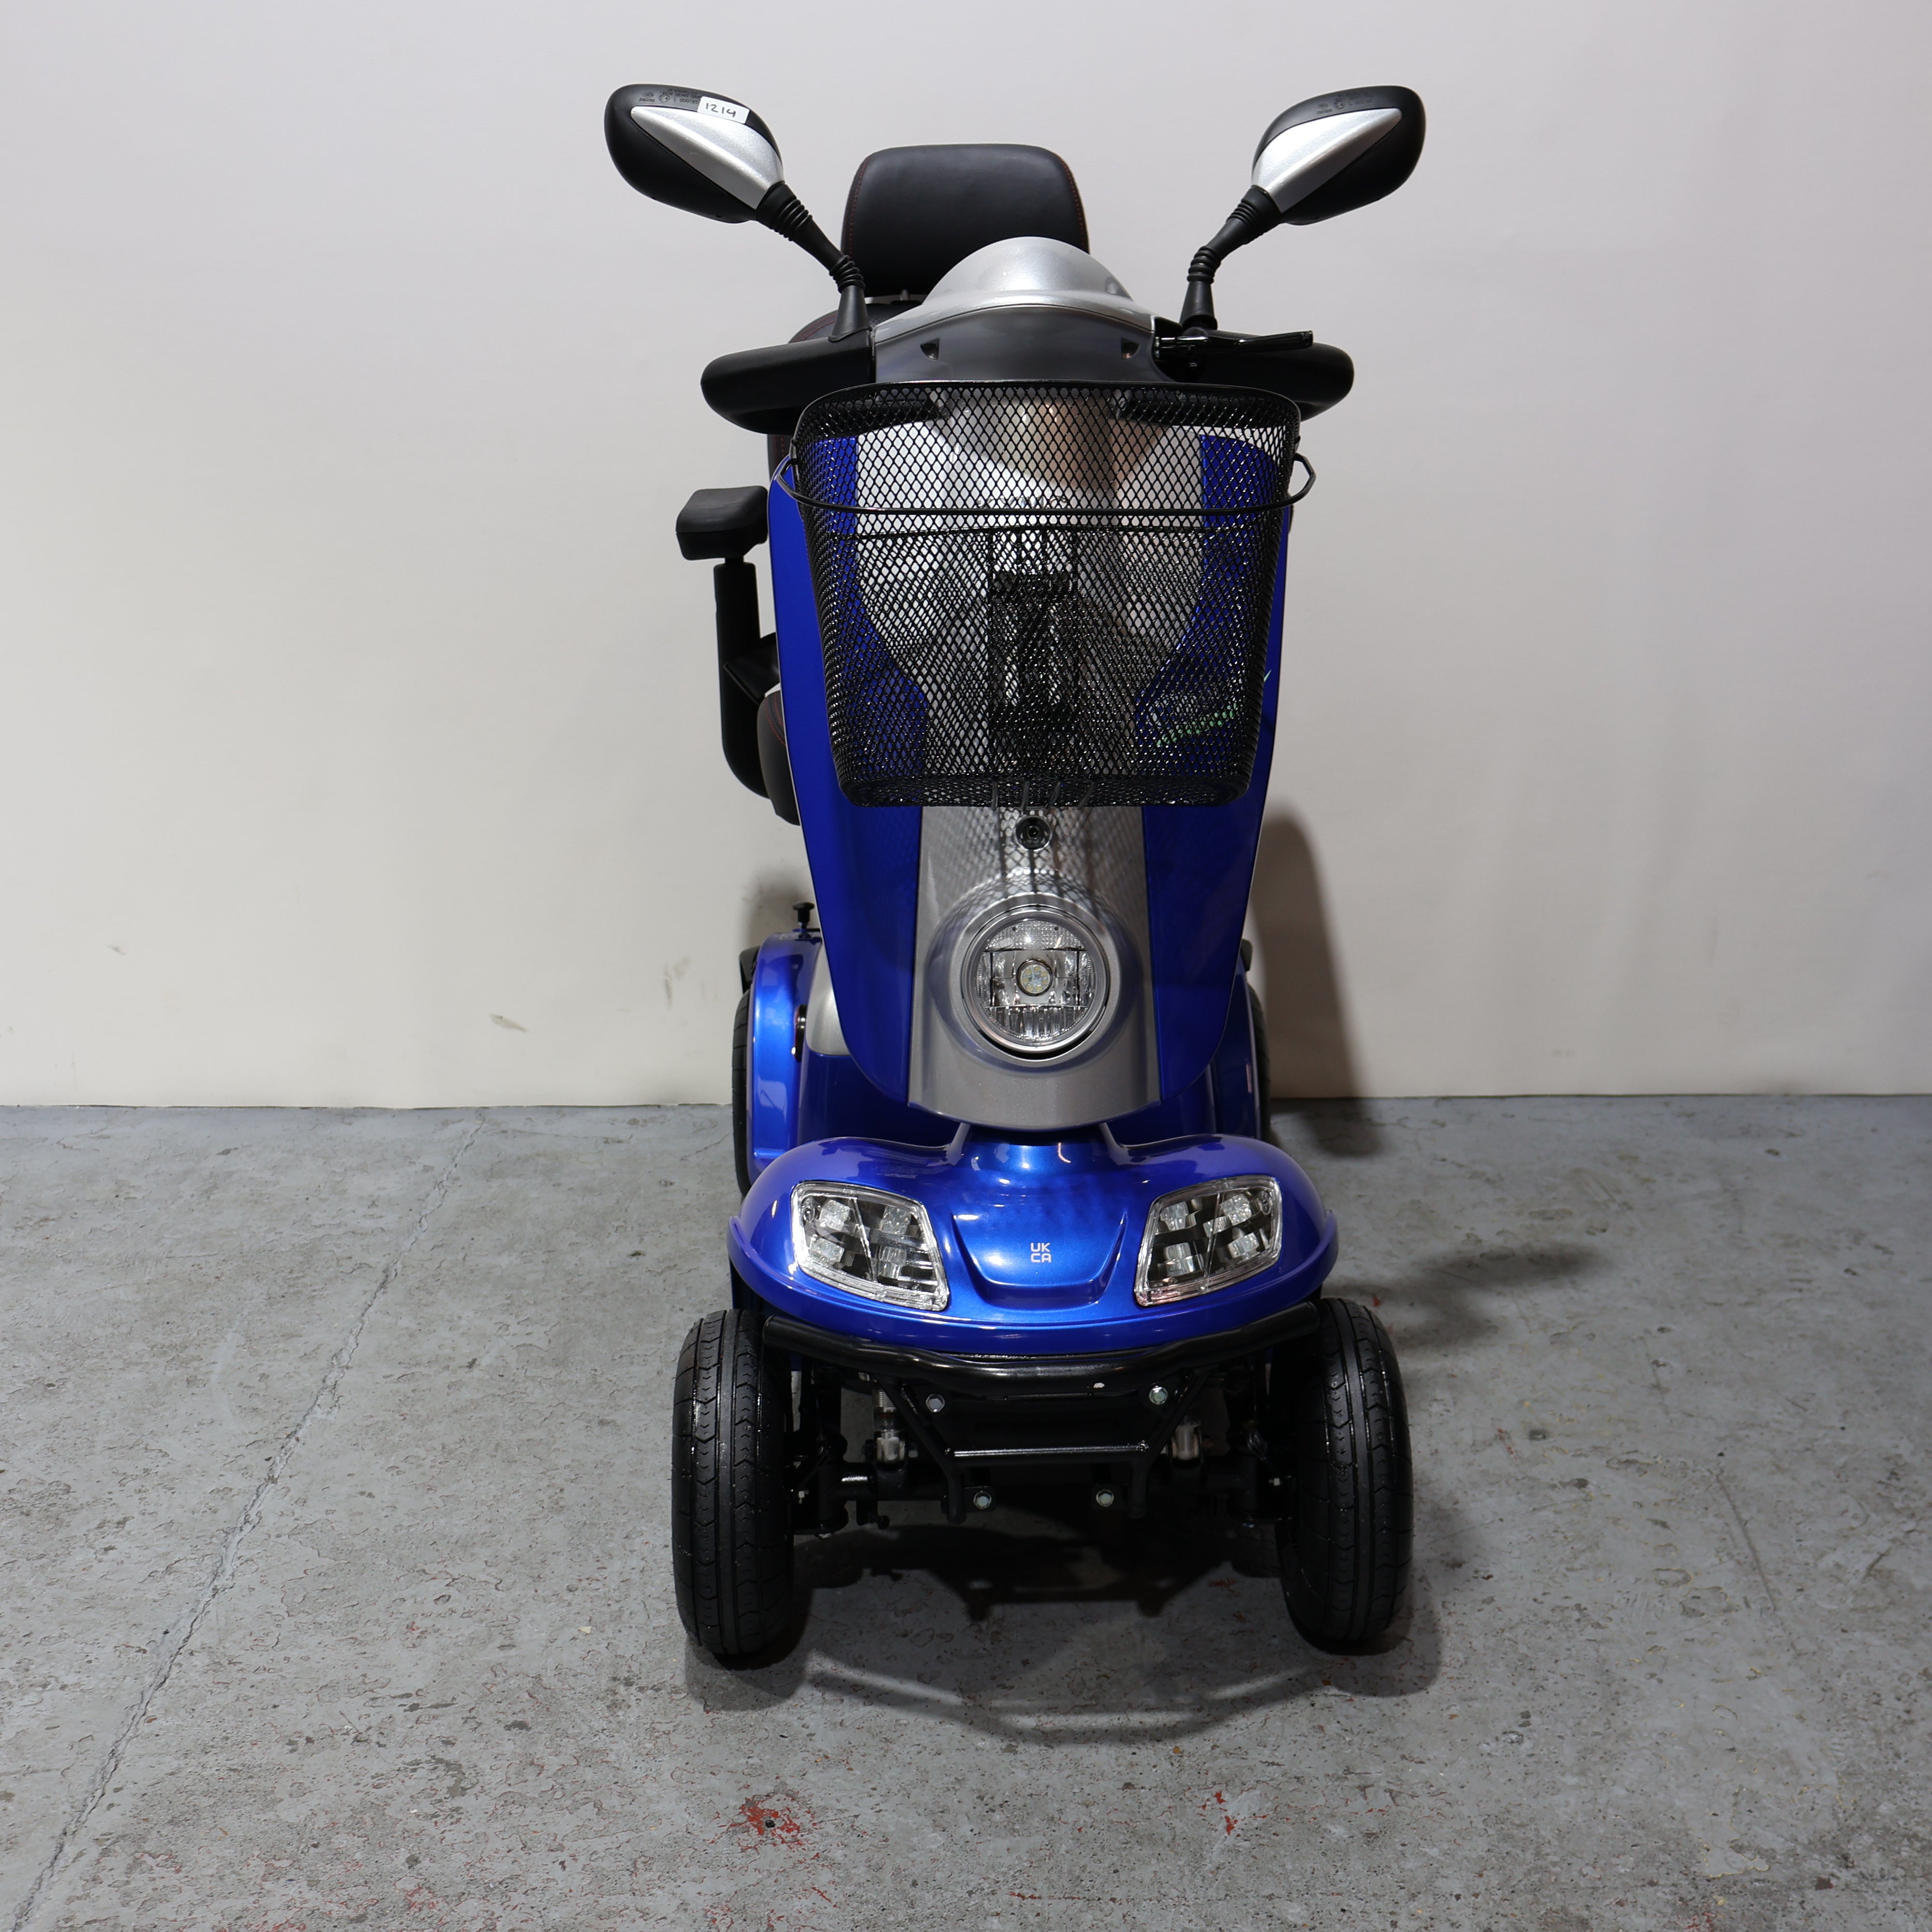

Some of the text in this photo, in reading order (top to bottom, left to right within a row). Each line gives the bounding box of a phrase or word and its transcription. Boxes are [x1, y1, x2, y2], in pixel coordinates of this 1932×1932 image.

[706, 103, 736, 118] 1214
[1030, 1242, 1051, 1252] UK
[1030, 1252, 1051, 1263] CA
